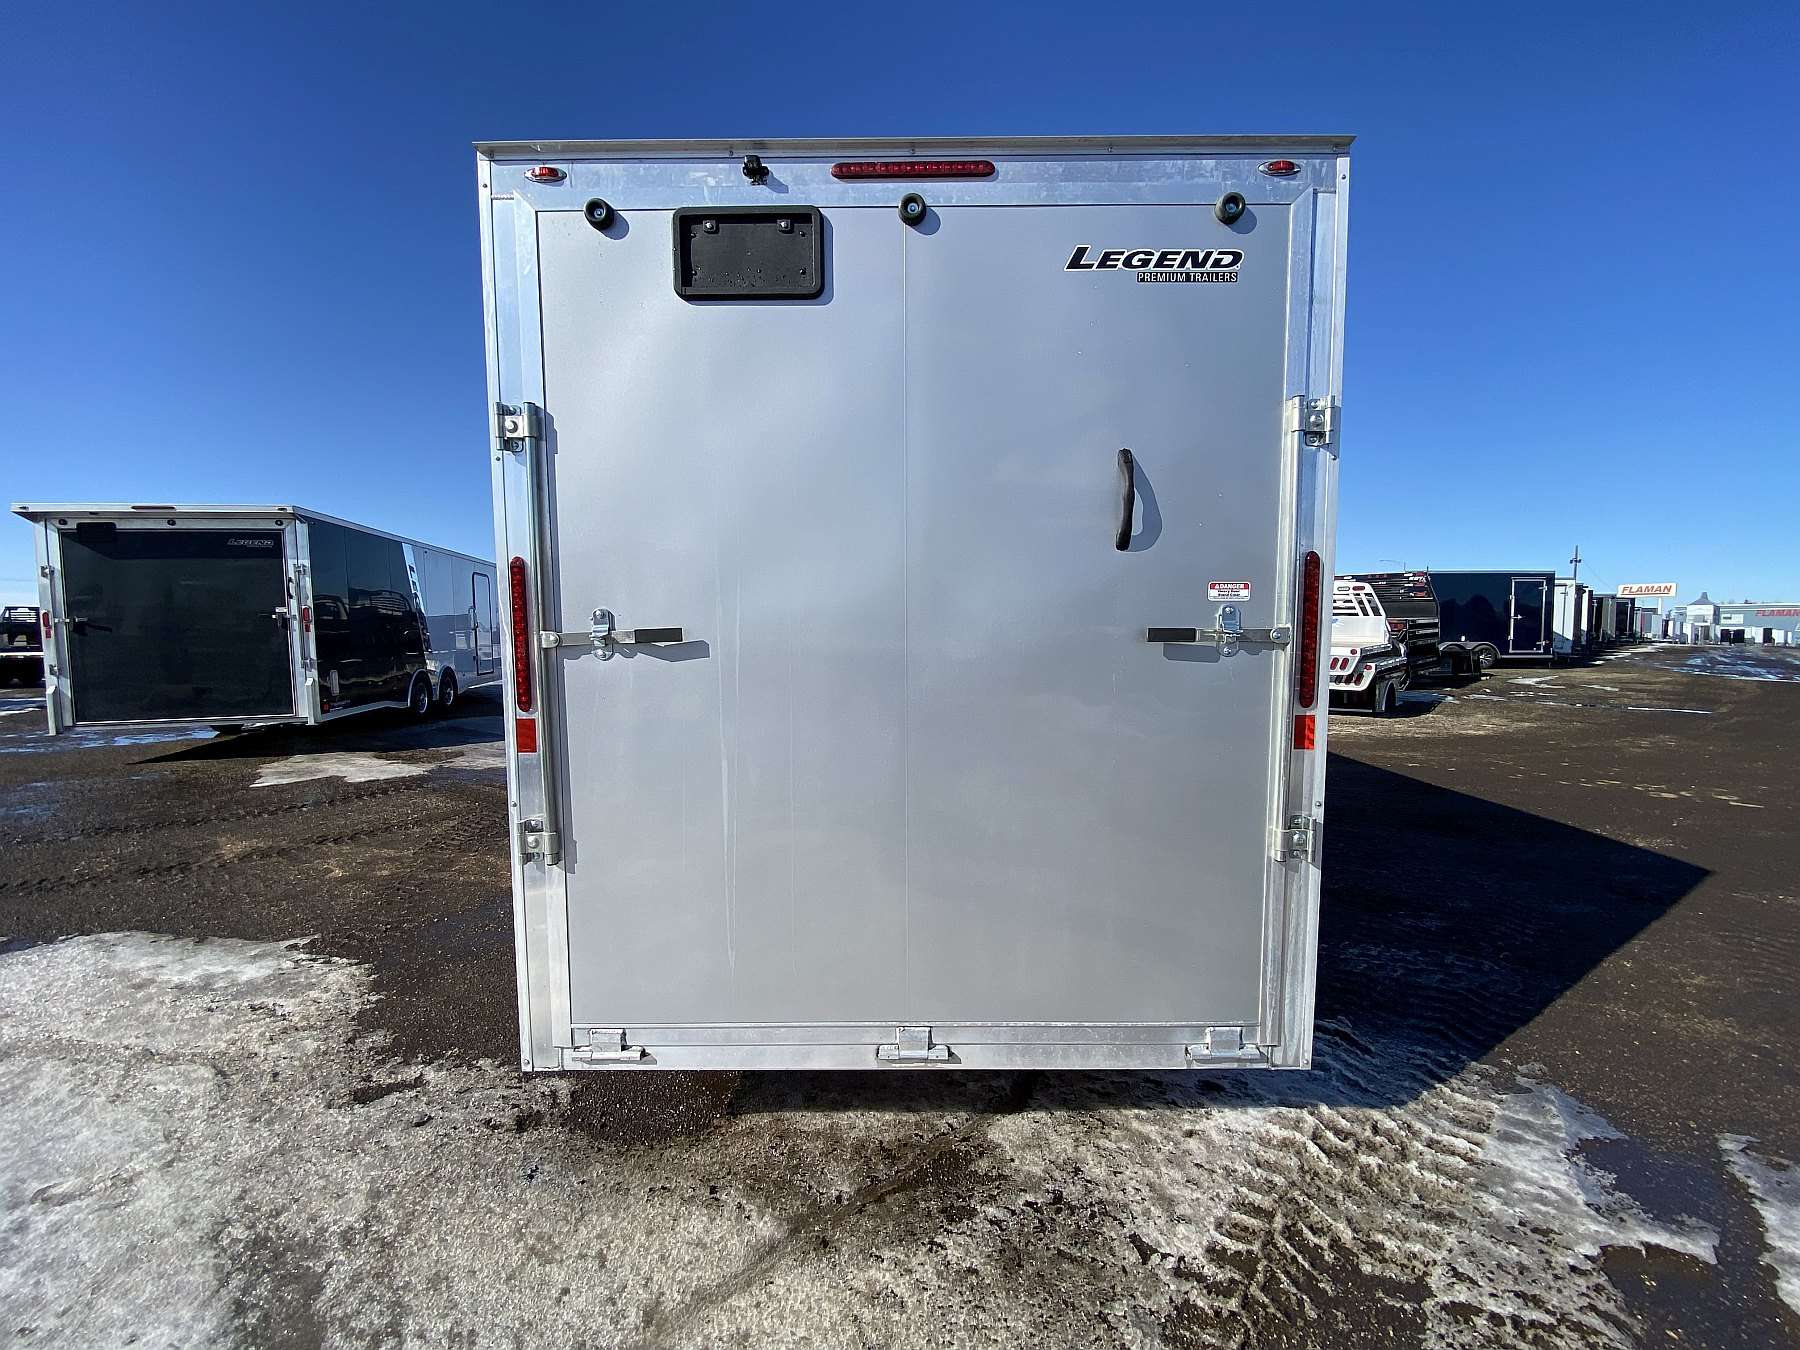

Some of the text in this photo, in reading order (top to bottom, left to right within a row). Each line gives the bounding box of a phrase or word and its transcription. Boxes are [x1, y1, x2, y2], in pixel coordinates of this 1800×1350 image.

[1065, 245, 1244, 271] LEGEND
[1138, 272, 1237, 282] PREMIUM TRAILERS
[1621, 584, 1673, 594] FLAMAN
